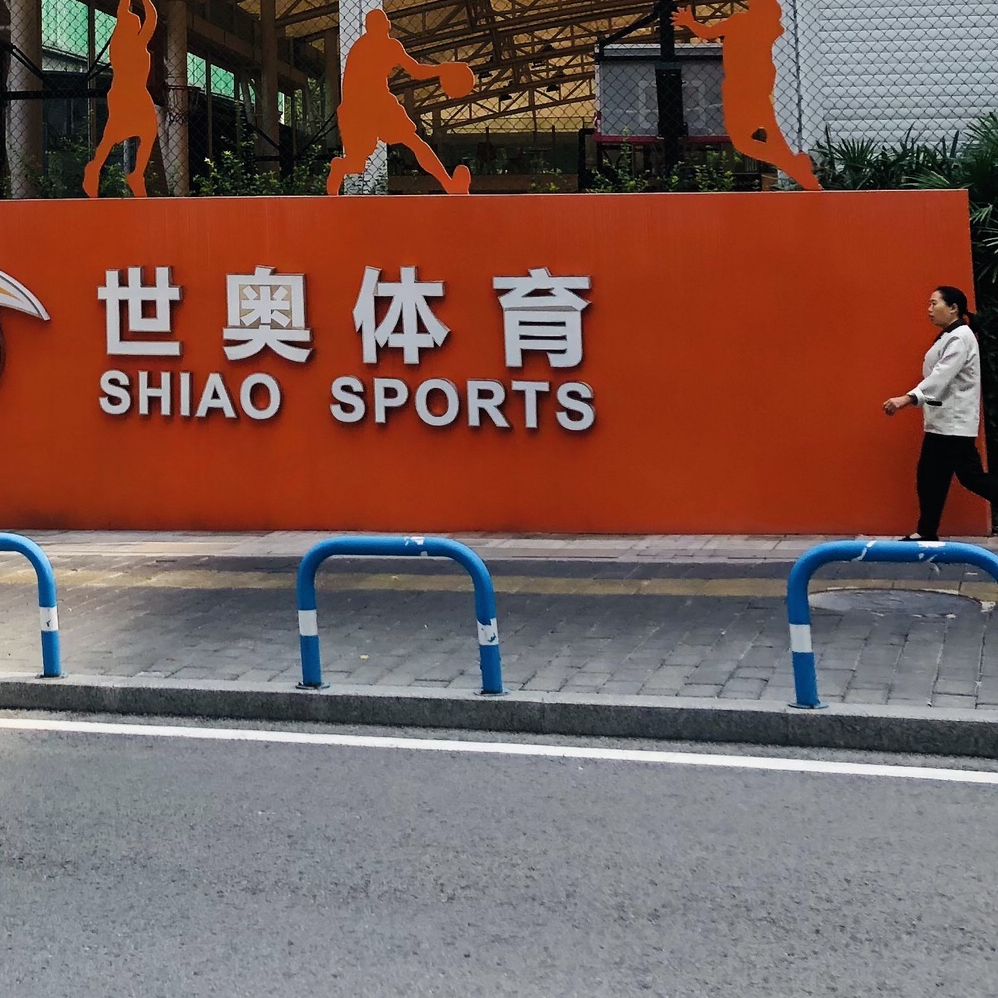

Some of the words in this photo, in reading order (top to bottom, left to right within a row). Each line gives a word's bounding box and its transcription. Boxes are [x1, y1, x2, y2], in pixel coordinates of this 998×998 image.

[97, 265, 592, 369] 世奥体育
[98, 369, 282, 422] SHIAO
[329, 374, 596, 433] SPORTS
